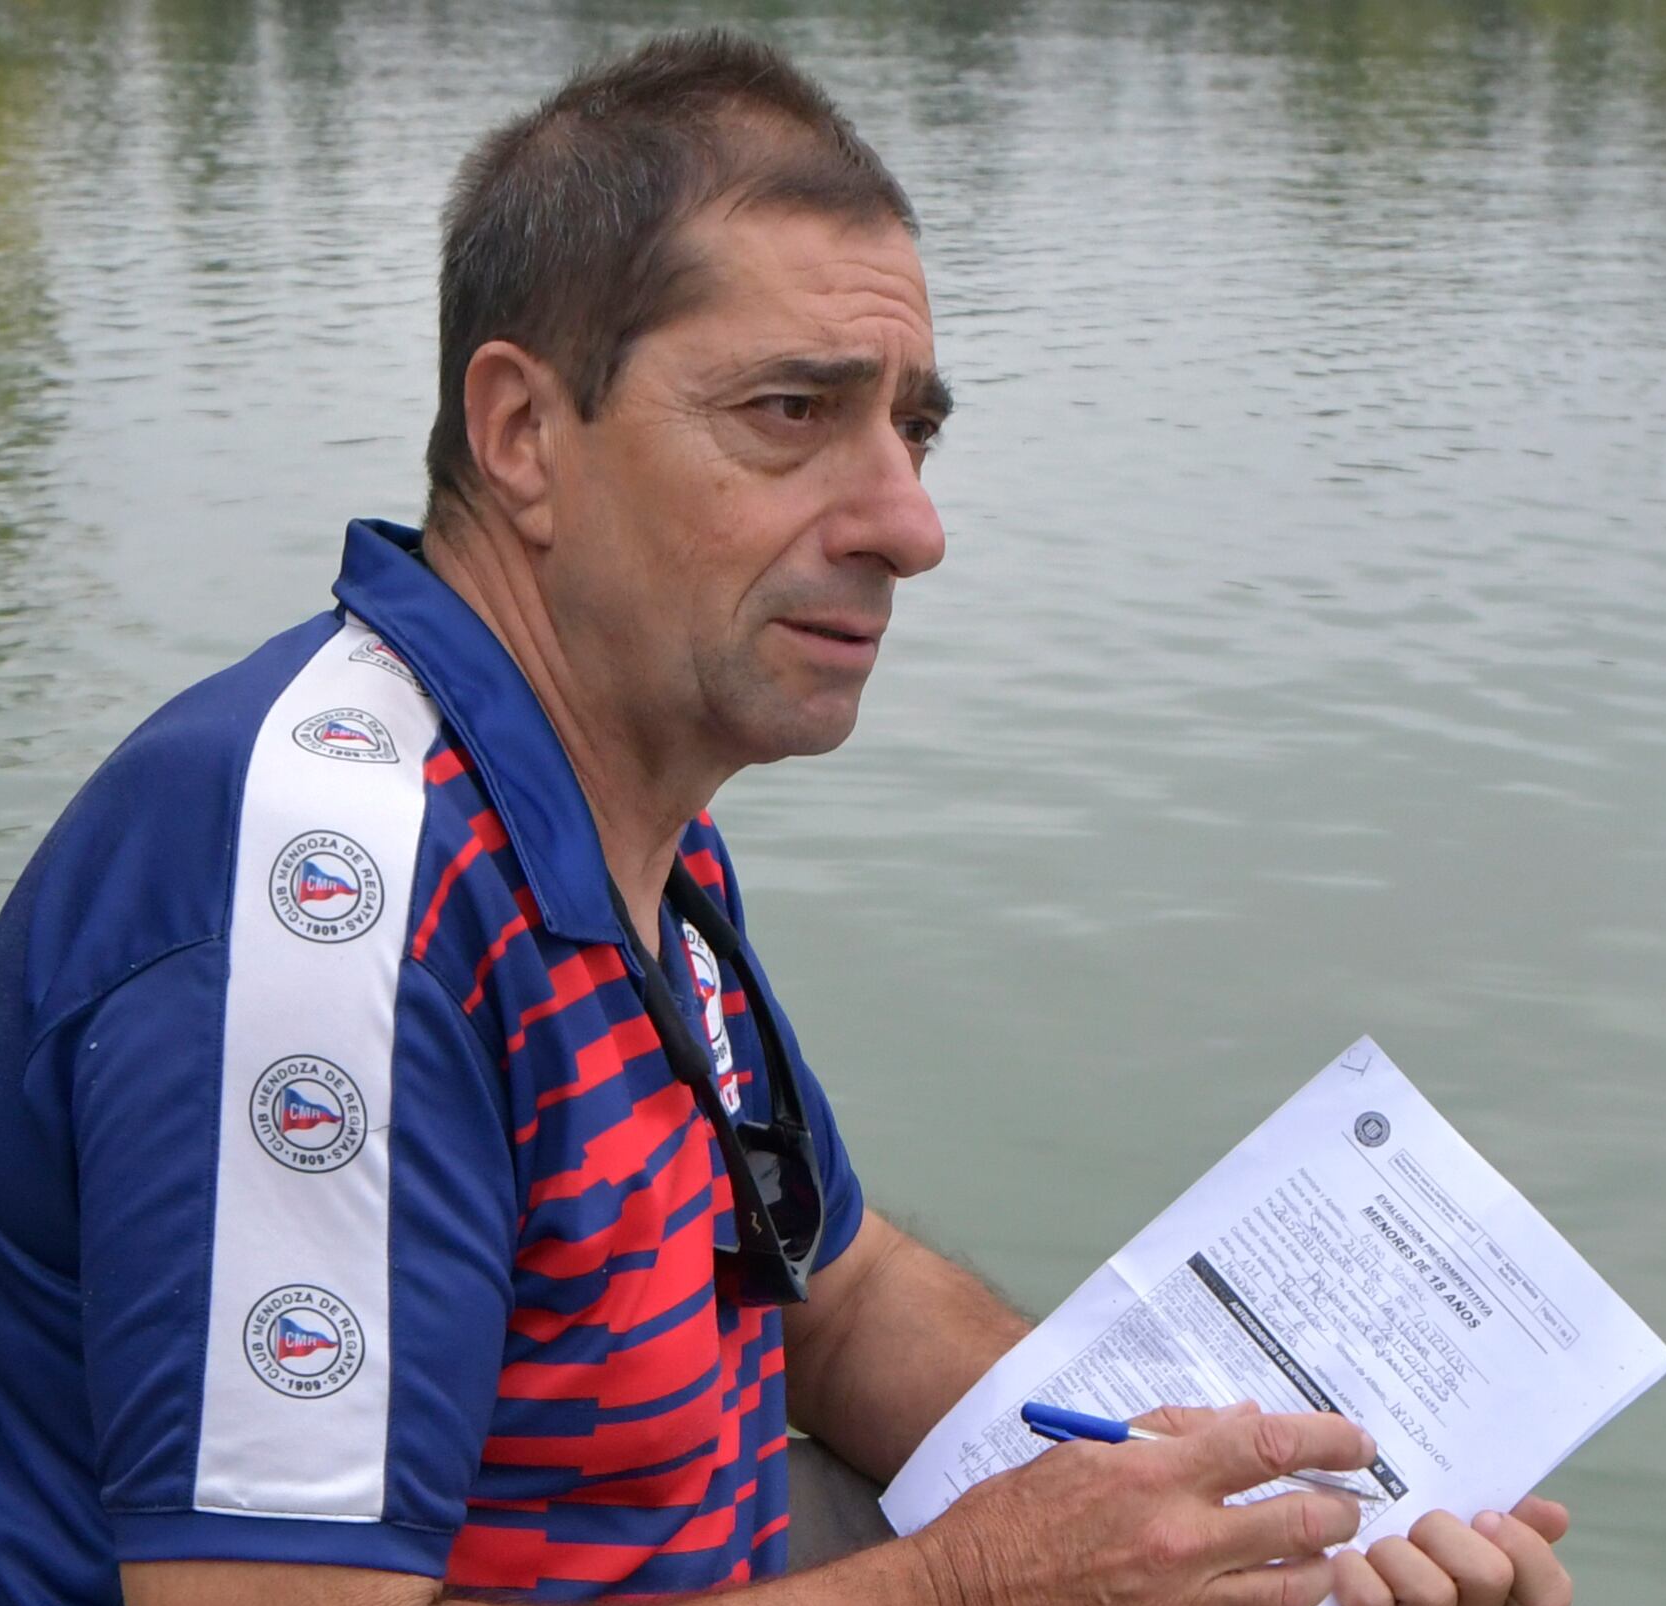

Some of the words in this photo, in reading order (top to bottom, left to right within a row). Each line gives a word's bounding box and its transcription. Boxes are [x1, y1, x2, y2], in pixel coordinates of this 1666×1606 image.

[368, 719, 383, 736] DE
[277, 837, 338, 880] MENDOZA
[343, 845, 364, 864] DE
[276, 886, 299, 923] CLUB
[345, 868, 377, 931] REGATAS
[306, 922, 338, 936] 1909
[258, 1062, 319, 1106] MENDOZA
[324, 1070, 345, 1089] DE
[257, 1113, 284, 1152] CLUB
[332, 1093, 361, 1159] REGATAS
[291, 1152, 325, 1165] 1909
[1361, 1202, 1417, 1262] MENORES
[1411, 1256, 1431, 1276] DE
[1427, 1272, 1448, 1294] 18
[1441, 1287, 1483, 1331] AÑOS
[1374, 1190, 1426, 1245] EVALUACIÓN
[1421, 1240, 1494, 1318] PRE-COMPETITIVA
[253, 1292, 313, 1336] MENDOZA
[319, 1298, 340, 1316] DE
[1227, 1298, 1280, 1357] ANTECEDENTES
[252, 1342, 279, 1379] CLUB
[328, 1318, 357, 1384] REGATAS
[287, 1379, 321, 1392] 1909
[1387, 1478, 1402, 1495] NO
